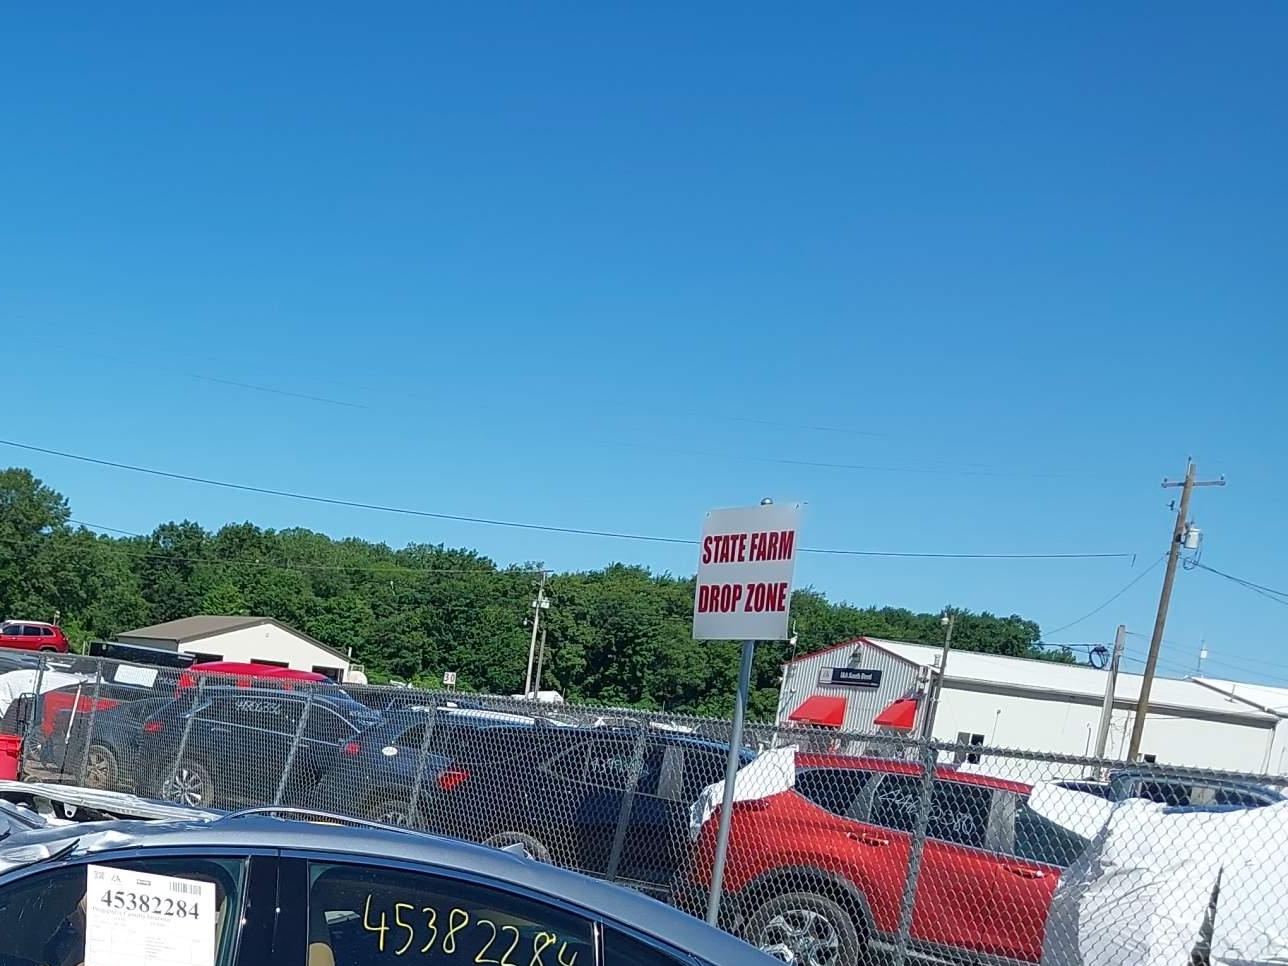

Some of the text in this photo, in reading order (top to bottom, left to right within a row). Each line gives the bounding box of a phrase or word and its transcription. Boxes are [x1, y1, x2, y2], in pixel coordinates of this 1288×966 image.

[702, 531, 794, 564] STATE FARM
[698, 583, 787, 613] DROP ZONE
[101, 890, 199, 919] 45382284
